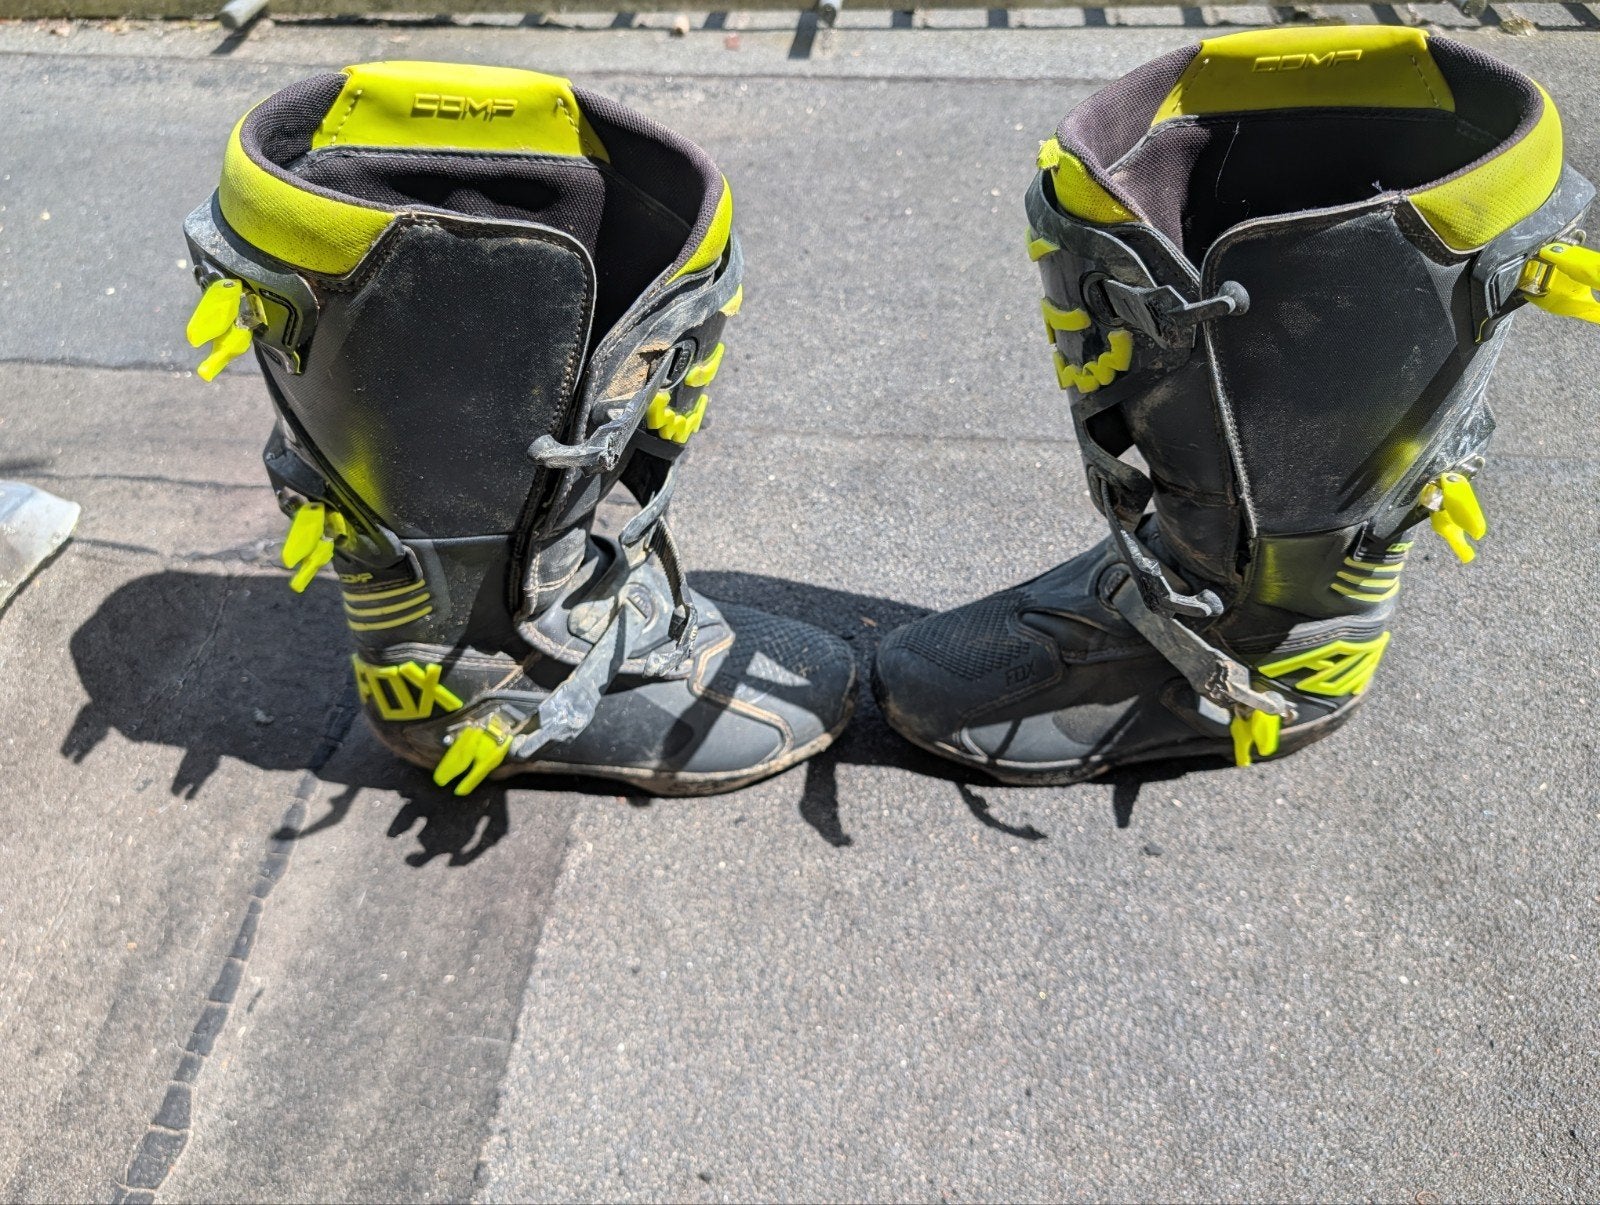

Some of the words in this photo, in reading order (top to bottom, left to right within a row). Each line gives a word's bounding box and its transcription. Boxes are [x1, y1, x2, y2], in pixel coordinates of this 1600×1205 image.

[1252, 49, 1363, 72] COMP
[410, 93, 518, 121] COMP
[1005, 659, 1036, 687] FOX
